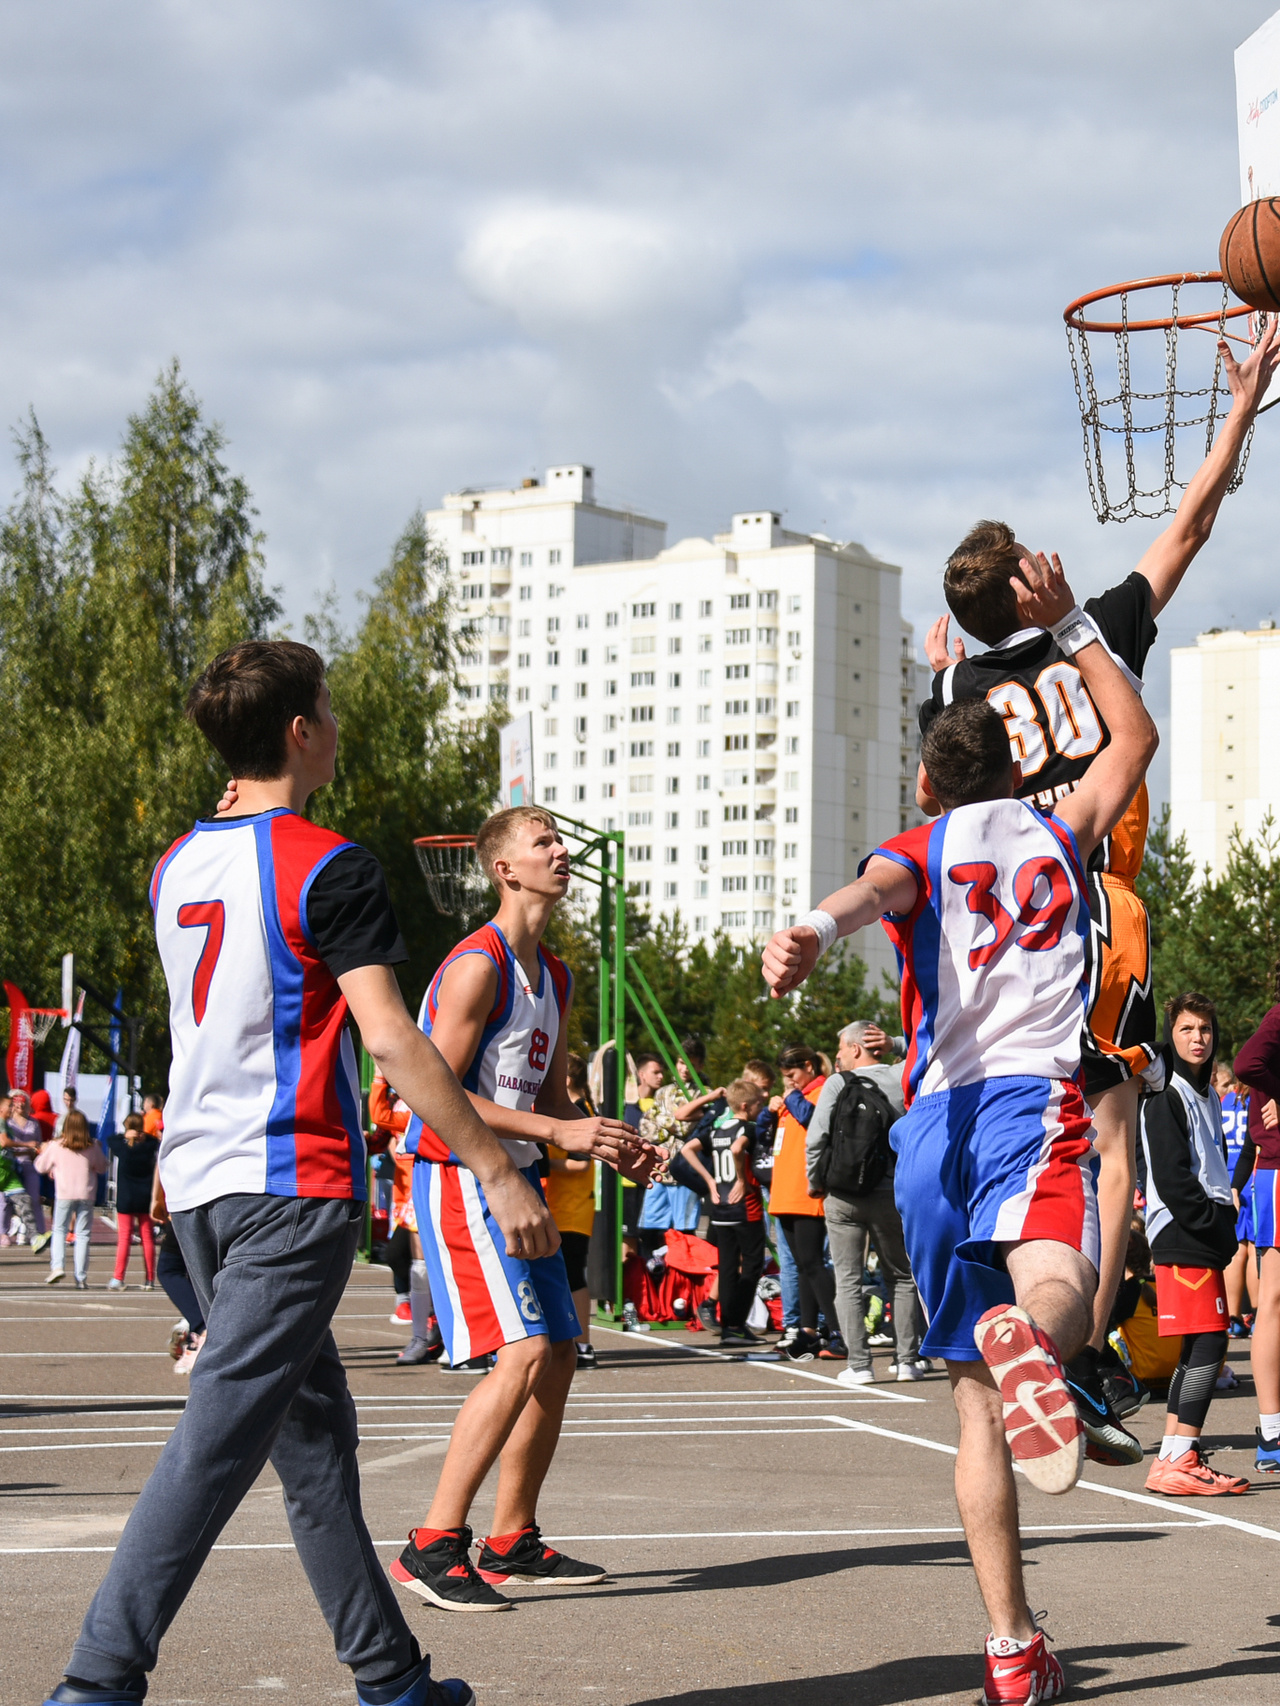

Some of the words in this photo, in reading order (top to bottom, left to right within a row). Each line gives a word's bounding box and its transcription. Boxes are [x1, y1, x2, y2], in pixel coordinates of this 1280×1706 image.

[986, 661, 1103, 777] 30
[177, 899, 225, 1027] 7
[948, 856, 1073, 971] 39
[528, 1028, 549, 1071] 8
[712, 1149, 736, 1183] 10
